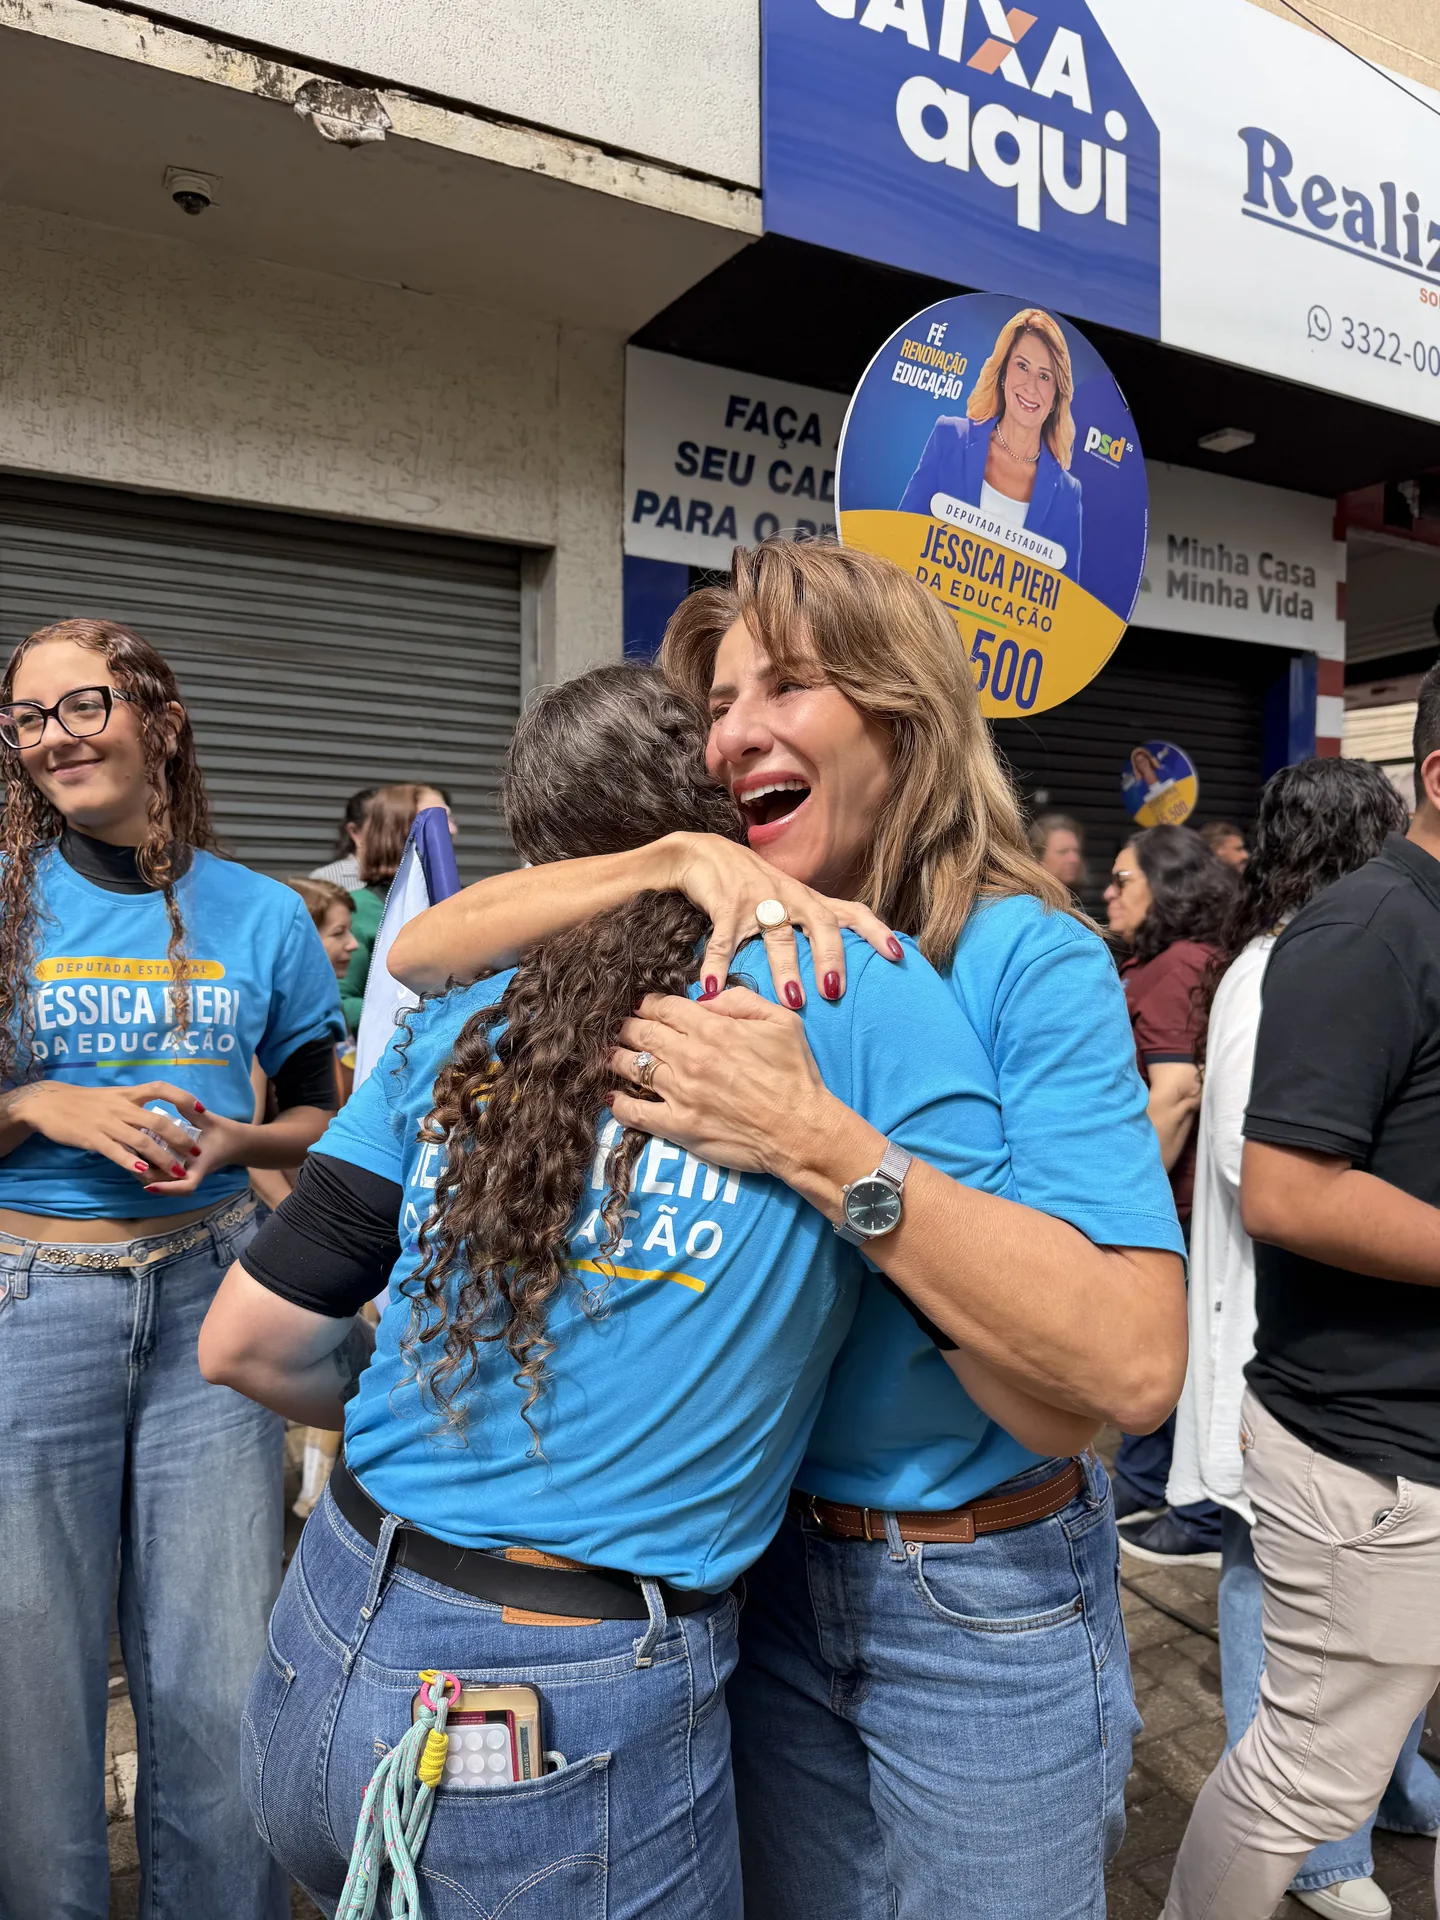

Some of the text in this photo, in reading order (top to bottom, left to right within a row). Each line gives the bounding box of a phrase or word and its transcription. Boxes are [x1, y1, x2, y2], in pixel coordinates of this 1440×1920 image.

[815, 0, 1093, 114] AIXA
[896, 76, 1127, 232] aqui
[1238, 126, 1440, 273] Realiz
[1420, 287, 1440, 309] SO
[900, 338, 968, 376] RENOVAÇÃO
[926, 322, 949, 347] FÉ
[1341, 316, 1440, 377] 3322-00
[891, 360, 964, 400] EDUCAÇÃO
[724, 395, 822, 449] FAÇA
[1084, 426, 1126, 462] psd
[674, 440, 756, 487] SEU
[632, 489, 738, 541] PARA
[945, 503, 1054, 560] DEPUTADA ESTADUAL
[919, 522, 1006, 589] JÉSSICA
[1008, 559, 1062, 611] PIERI
[1166, 533, 1316, 589] Minha Casa
[915, 566, 1054, 632] DA EDUCAÇÃO
[1166, 568, 1314, 622] Minha Vida
[969, 628, 1044, 710] 500
[56, 962, 207, 976] DEPUTADA ESTAAL
[31, 1028, 236, 1061] DA EDUCAÇÃO
